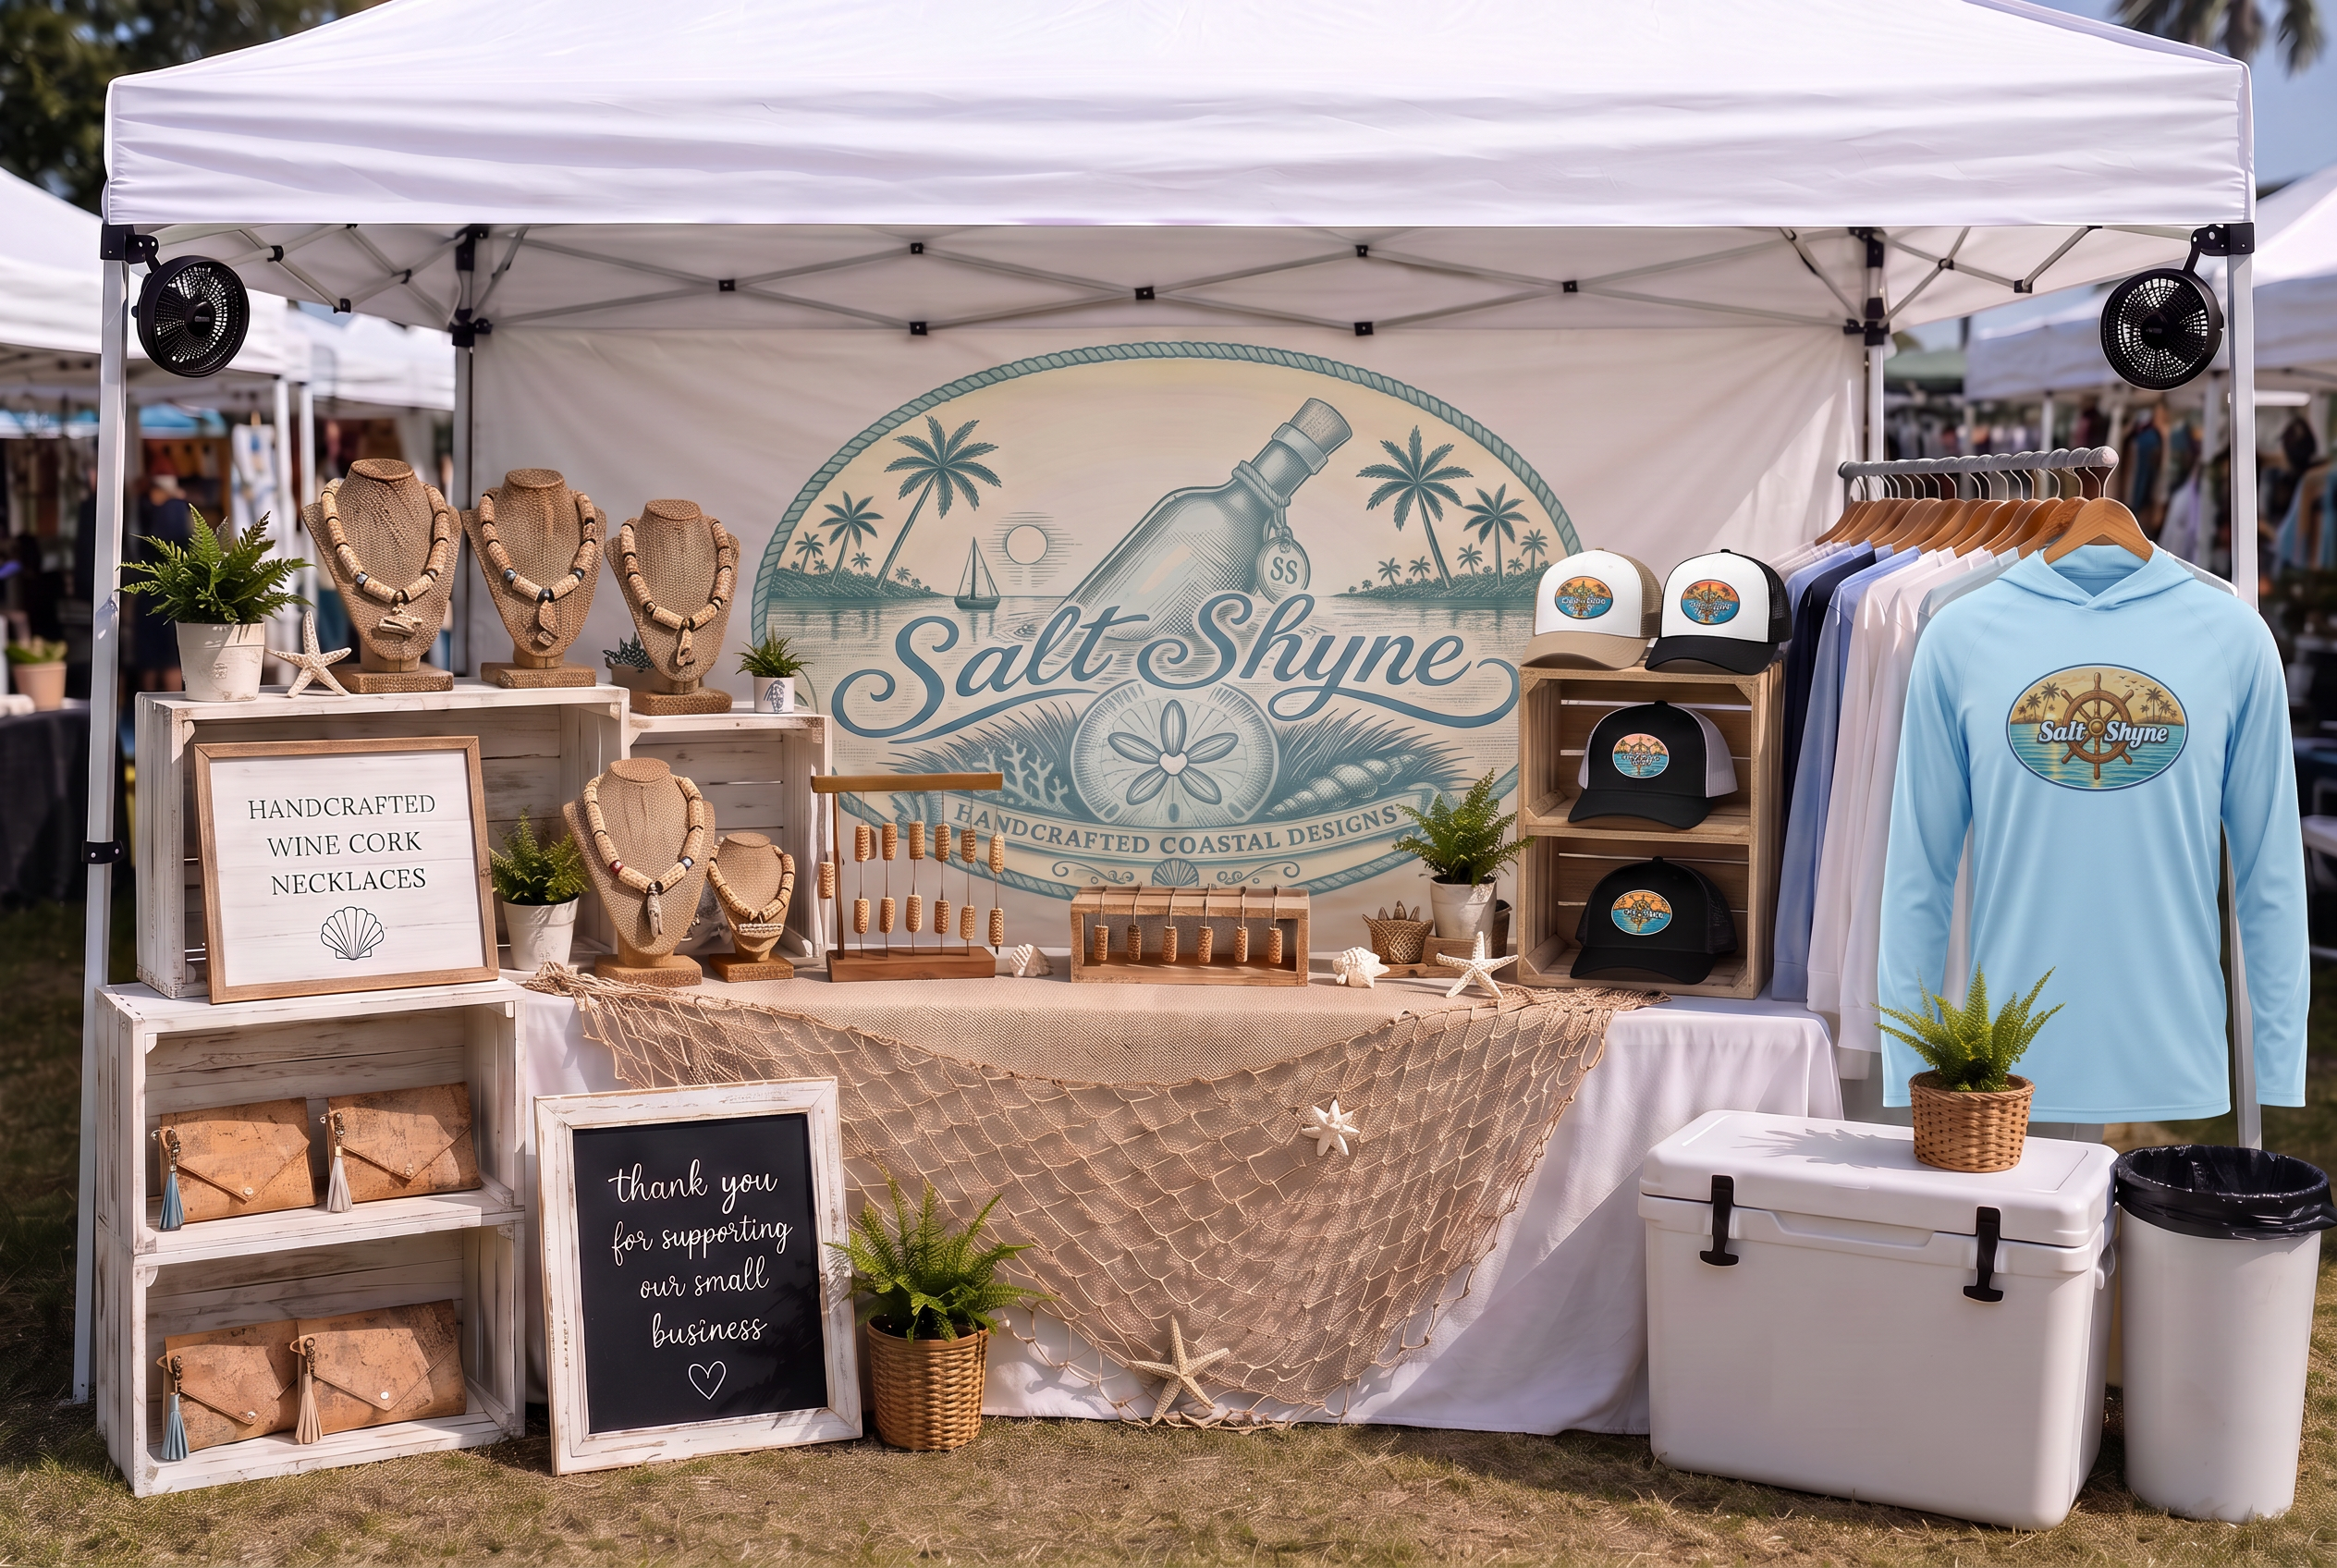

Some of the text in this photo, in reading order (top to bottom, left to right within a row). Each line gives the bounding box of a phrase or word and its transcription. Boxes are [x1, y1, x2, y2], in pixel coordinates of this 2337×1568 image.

[1270, 557, 1298, 584] SS
[832, 593, 1520, 744] Salt Shyne
[2037, 720, 2169, 750] Salt Shyne
[248, 794, 435, 819] HANDCRAFTED
[267, 831, 422, 857] WINE CORK
[954, 802, 1399, 855] HANDCRAFTED COASTAL DESIGNS
[271, 867, 426, 895] NECKLACES
[607, 1158, 777, 1214] thank you
[611, 1214, 793, 1266] for supporting
[640, 1255, 769, 1298] our small
[652, 1312, 768, 1348] business
